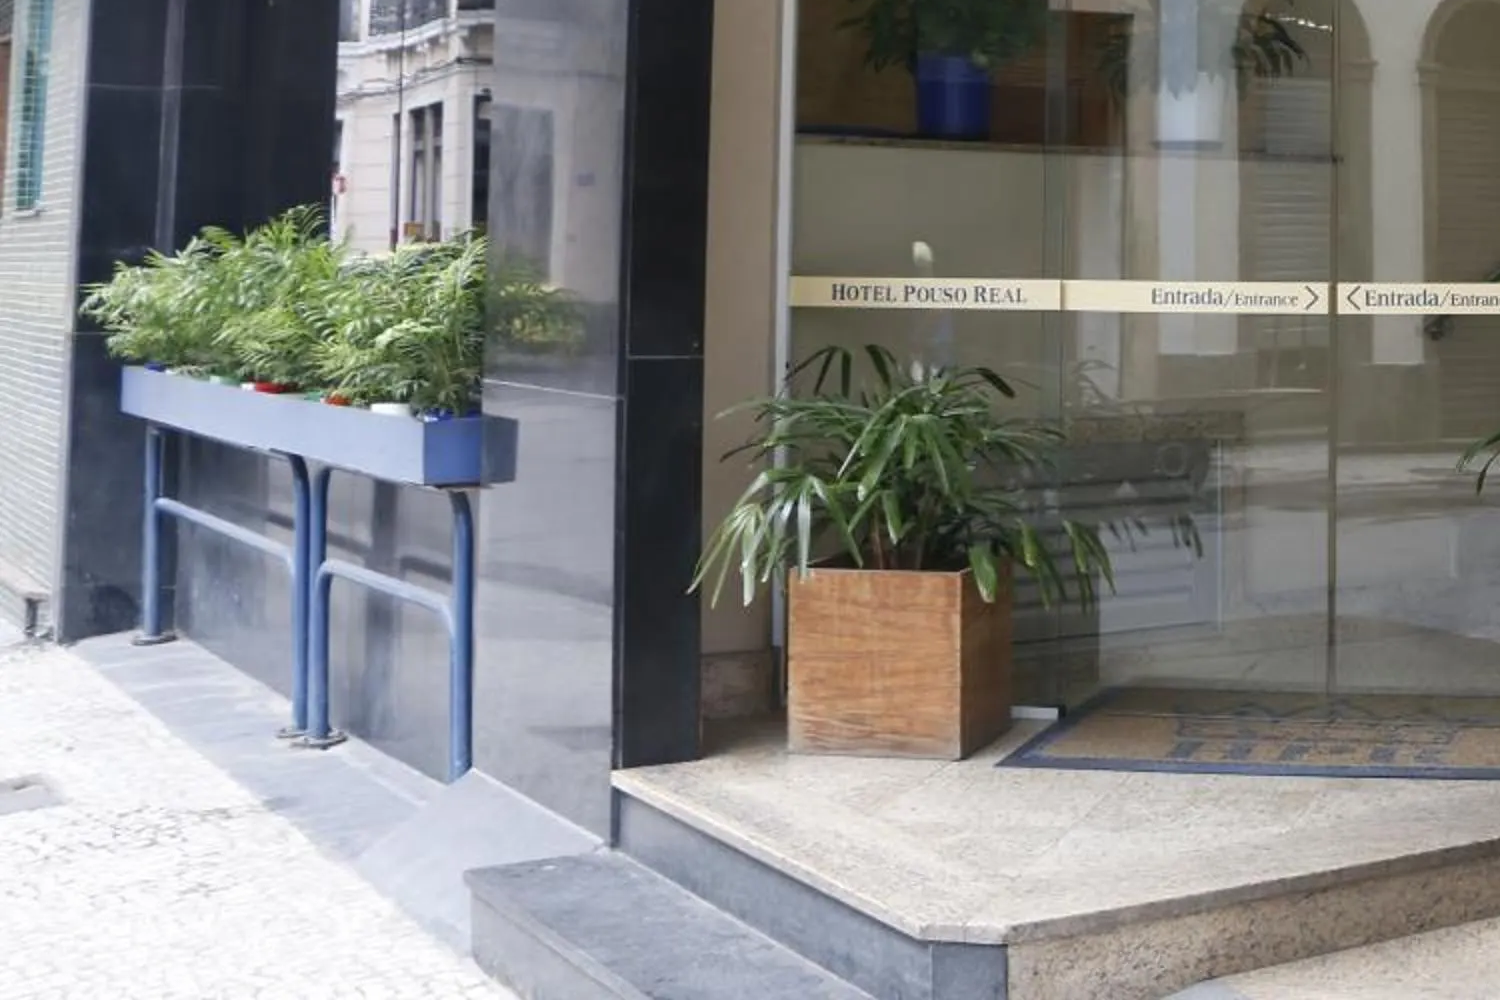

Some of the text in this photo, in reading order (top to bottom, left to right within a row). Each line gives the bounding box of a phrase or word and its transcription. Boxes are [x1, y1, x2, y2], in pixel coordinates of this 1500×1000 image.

[830, 282, 1028, 305] HOTEL POUSO REAL
